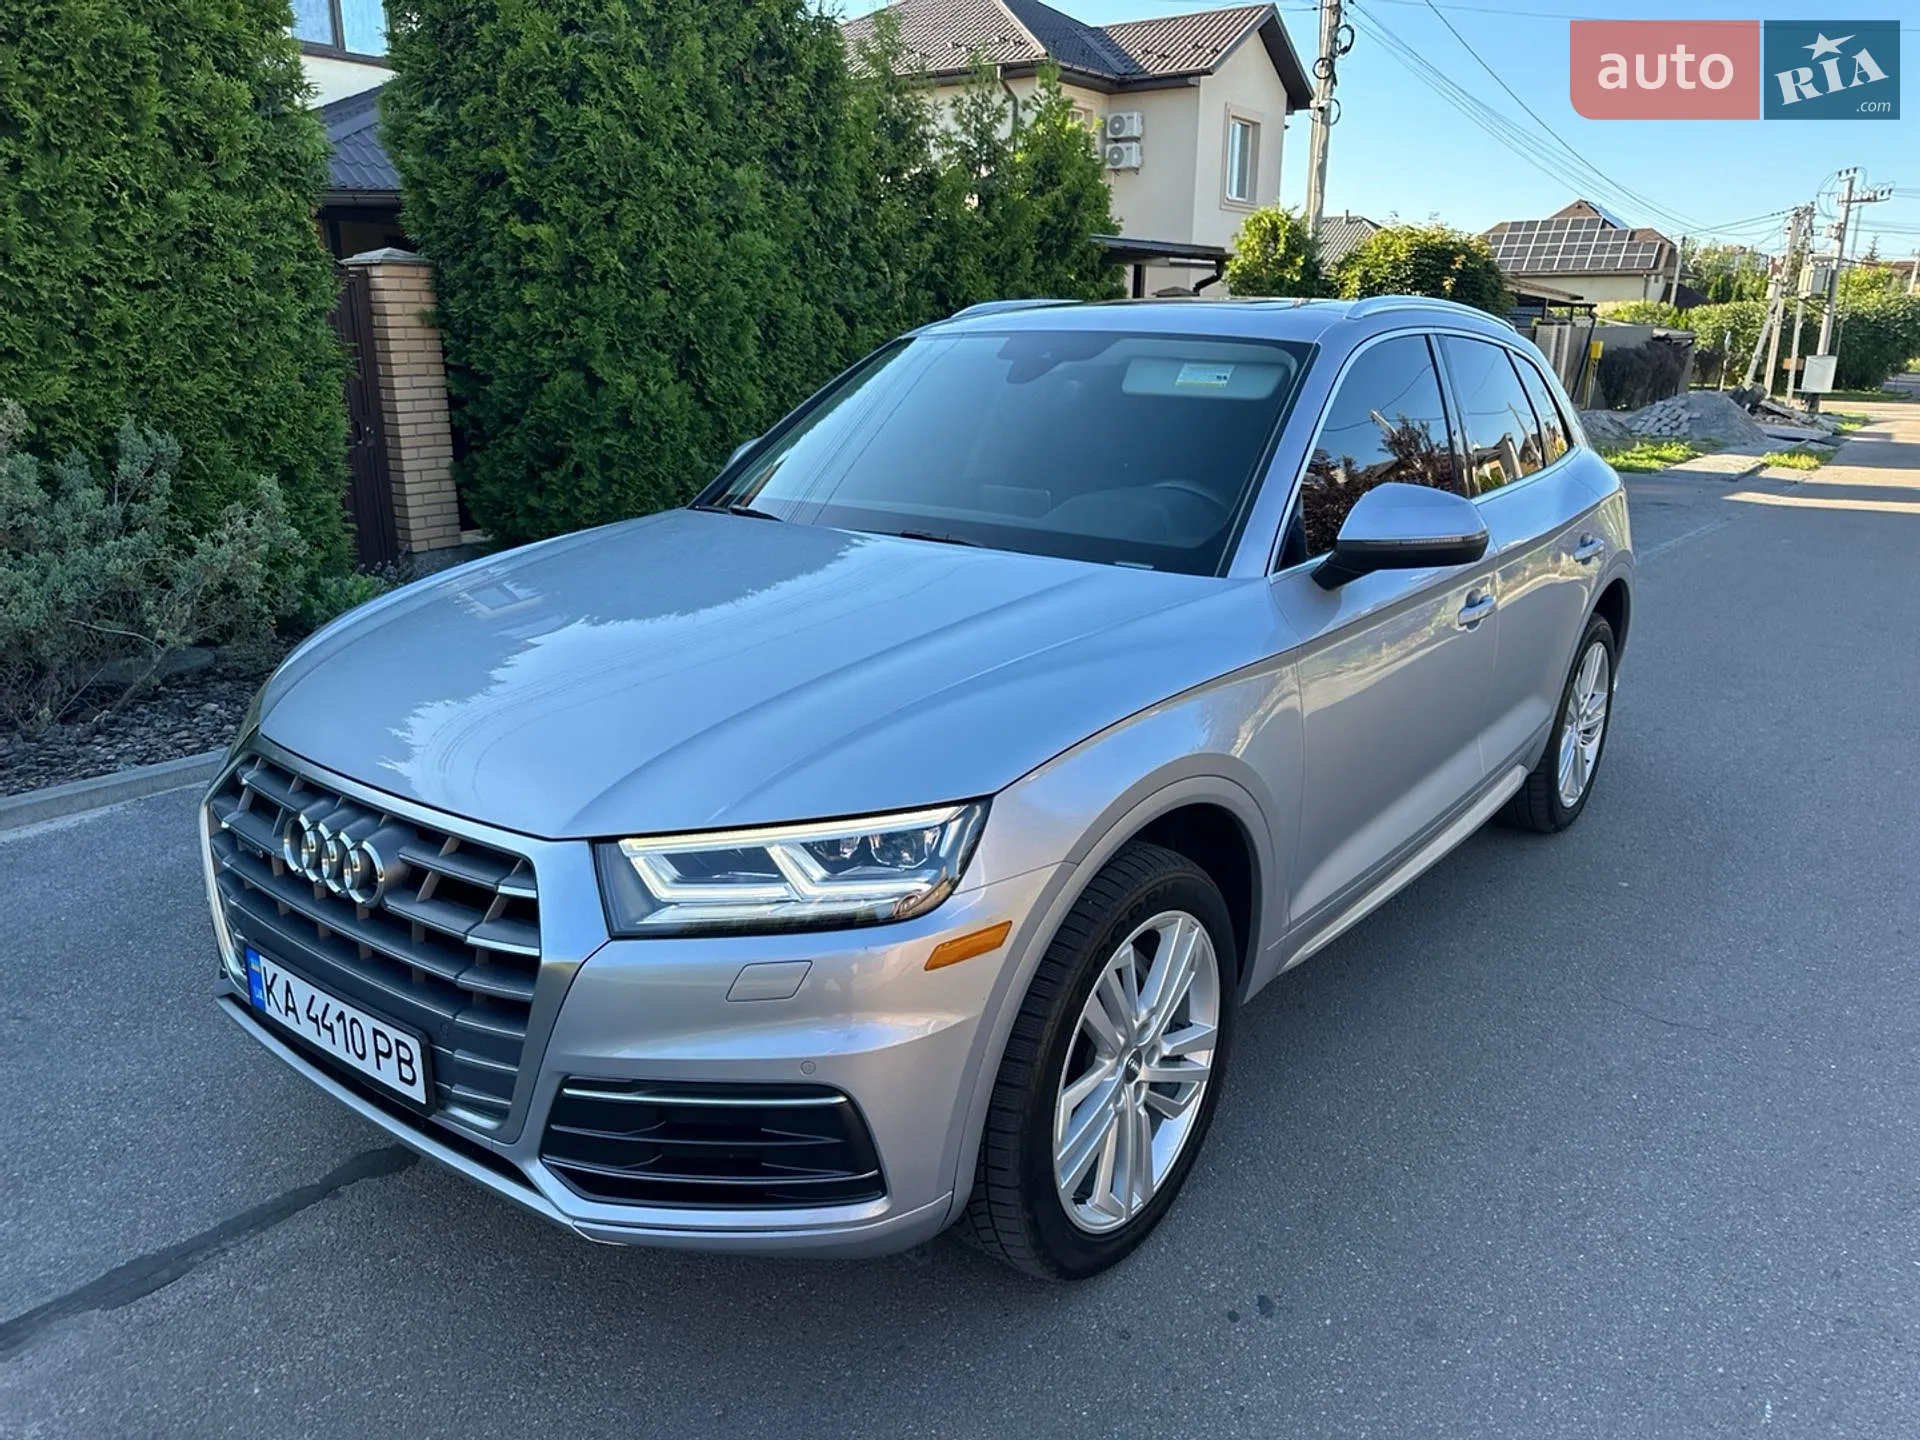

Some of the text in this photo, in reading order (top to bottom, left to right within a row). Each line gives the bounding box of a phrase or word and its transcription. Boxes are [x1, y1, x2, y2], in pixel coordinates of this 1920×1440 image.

[263, 966, 417, 1087] KA 4410 PB
